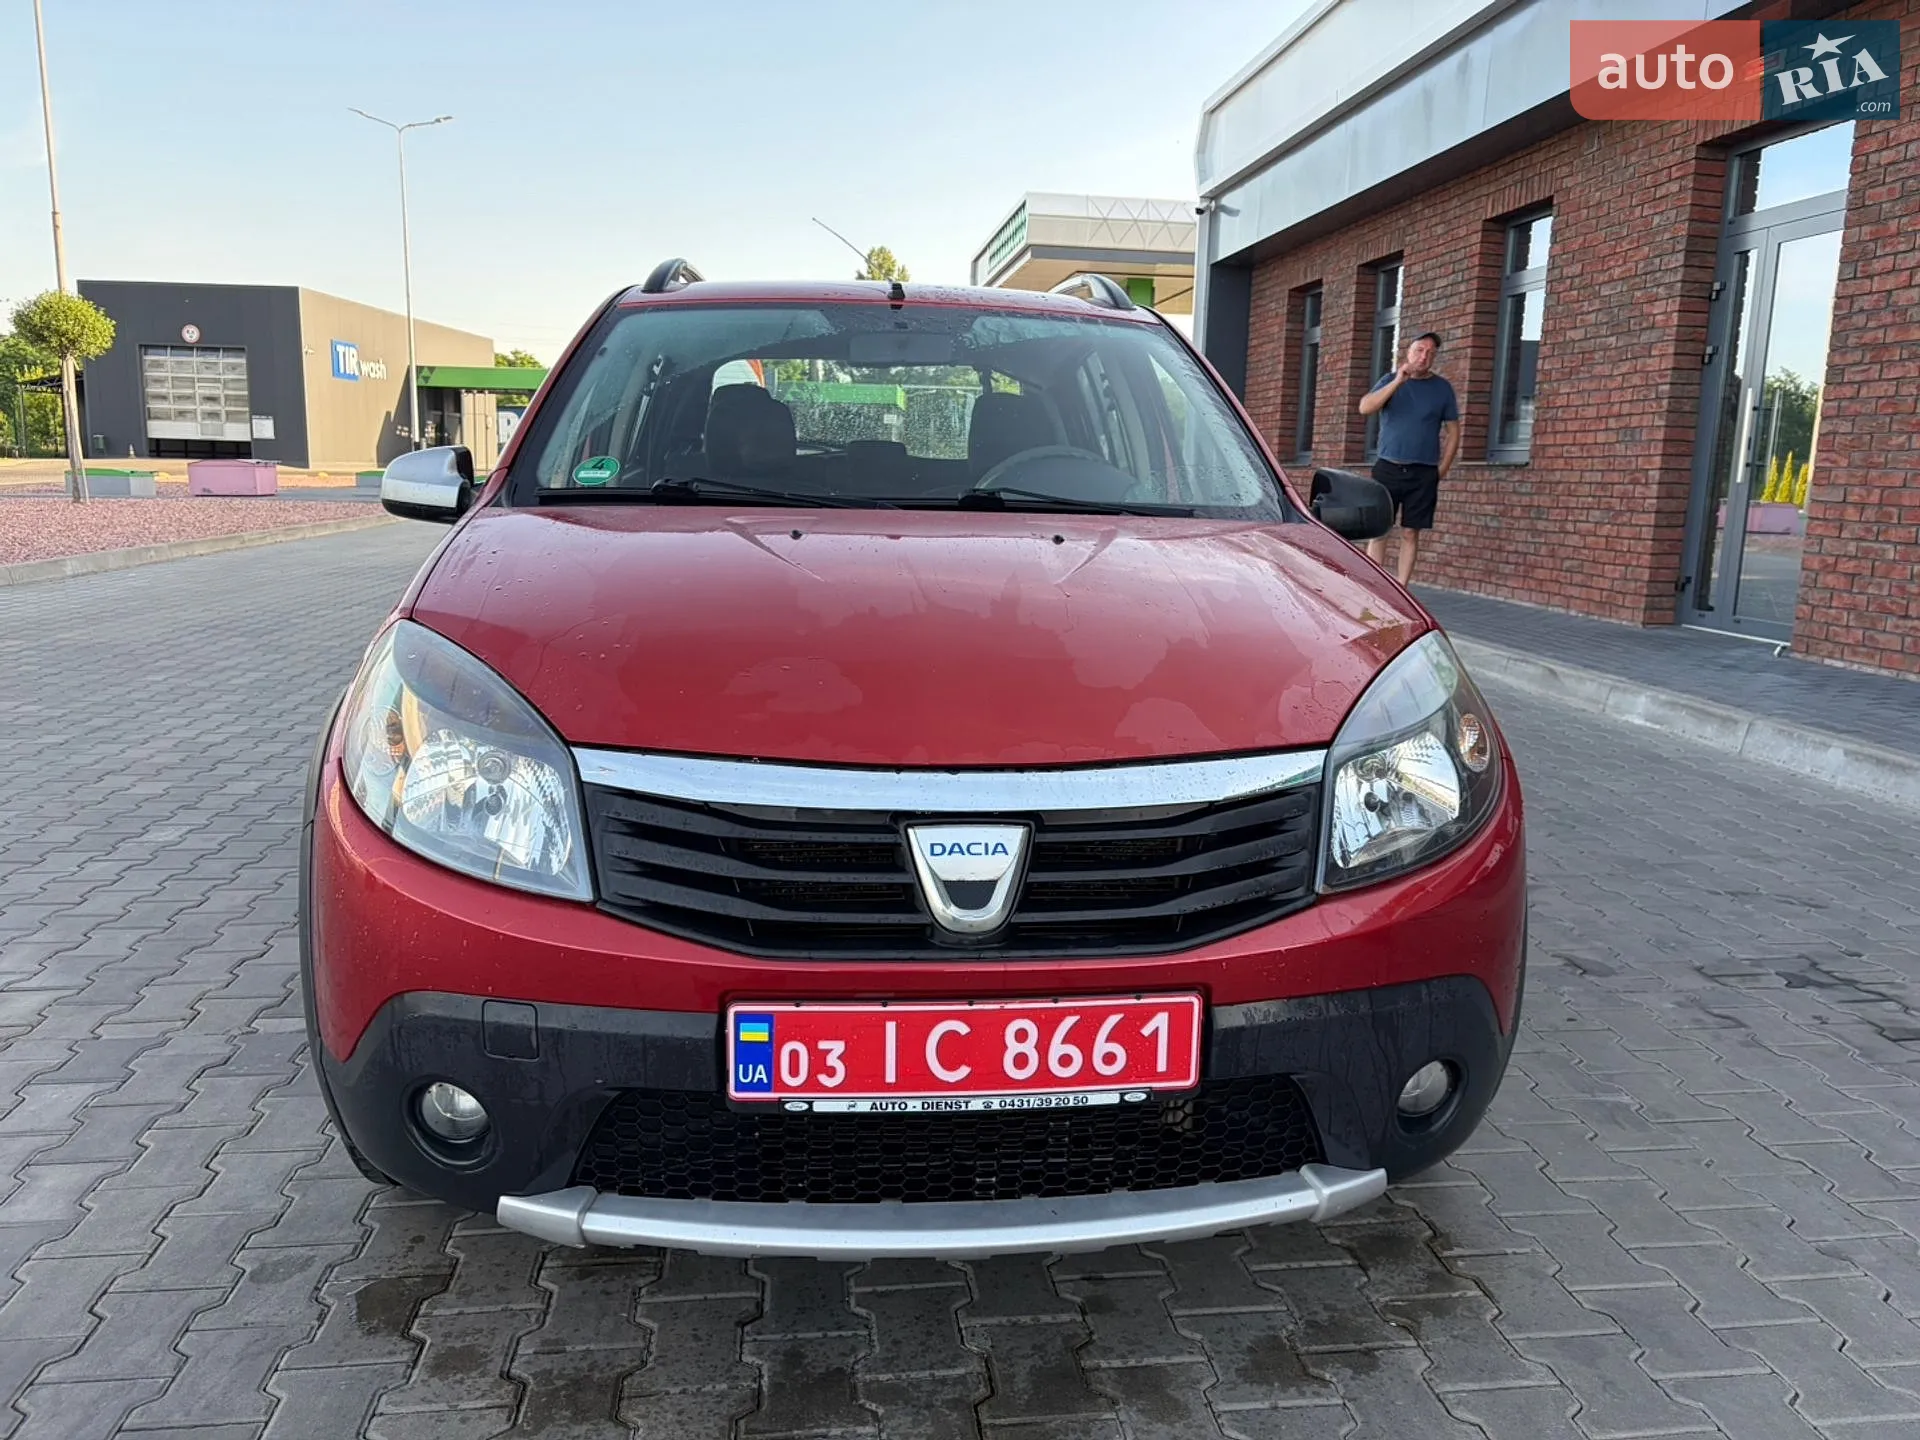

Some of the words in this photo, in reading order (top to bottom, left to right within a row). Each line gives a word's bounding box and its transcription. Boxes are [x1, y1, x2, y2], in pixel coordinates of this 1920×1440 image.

[336, 344, 359, 376] TIR
[360, 358, 387, 380] wash
[591, 458, 606, 470] 4
[930, 843, 1008, 856] DACIA
[779, 1040, 847, 1088] 03
[1002, 1011, 1169, 1081] 8661
[738, 1064, 768, 1084] UA
[870, 1101, 908, 1112] AUTO
[921, 1100, 972, 1111] DIENST
